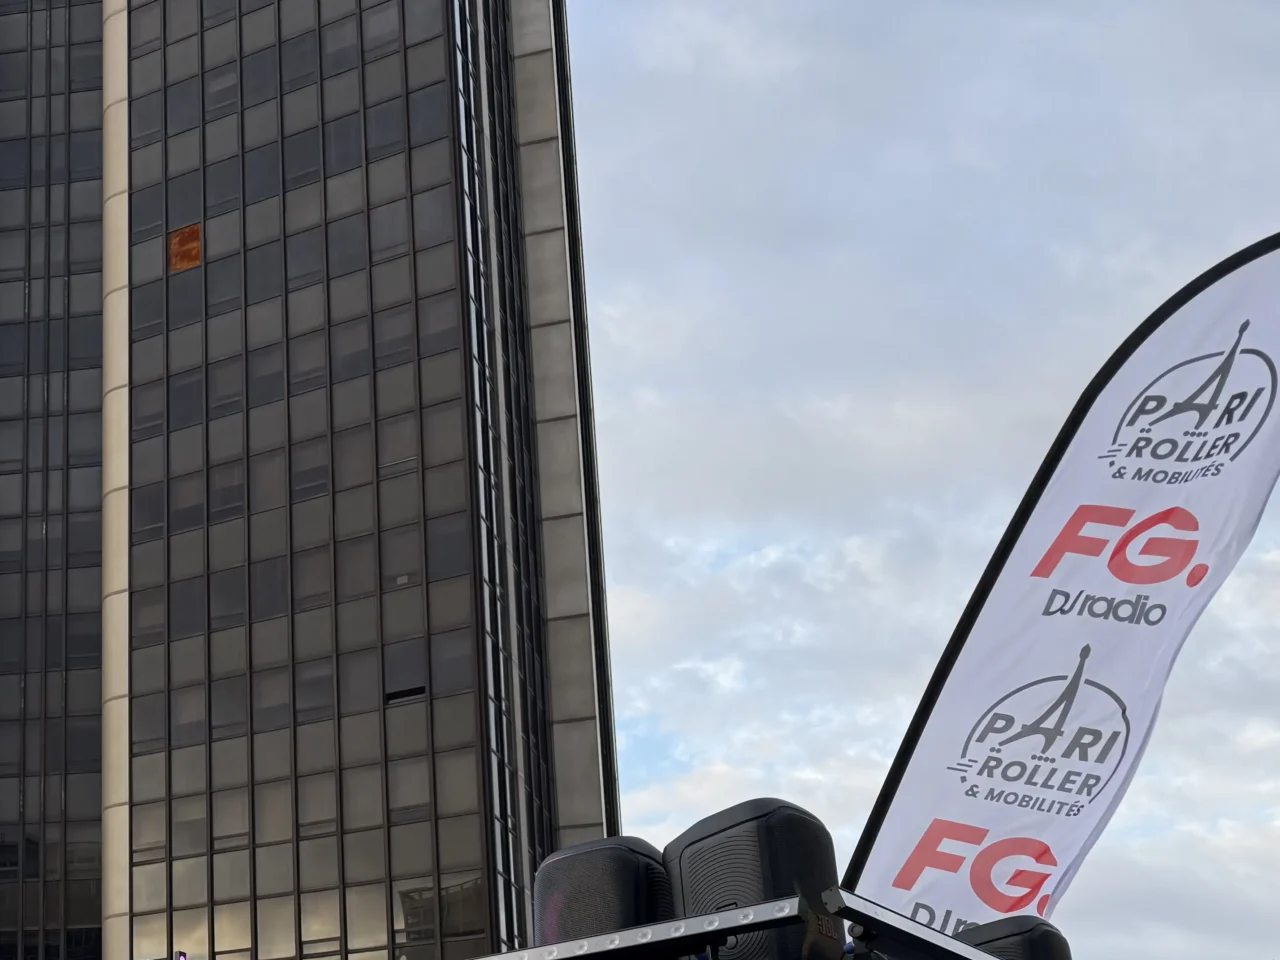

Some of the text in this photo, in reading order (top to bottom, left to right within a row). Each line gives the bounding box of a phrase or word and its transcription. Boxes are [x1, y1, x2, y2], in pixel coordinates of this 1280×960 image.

[1125, 432, 1241, 464] ROLLER
[1111, 460, 1225, 485] & MOBILITÉS
[976, 755, 1102, 797] ROLLER
[965, 784, 1085, 817] & MOBILITÉS
